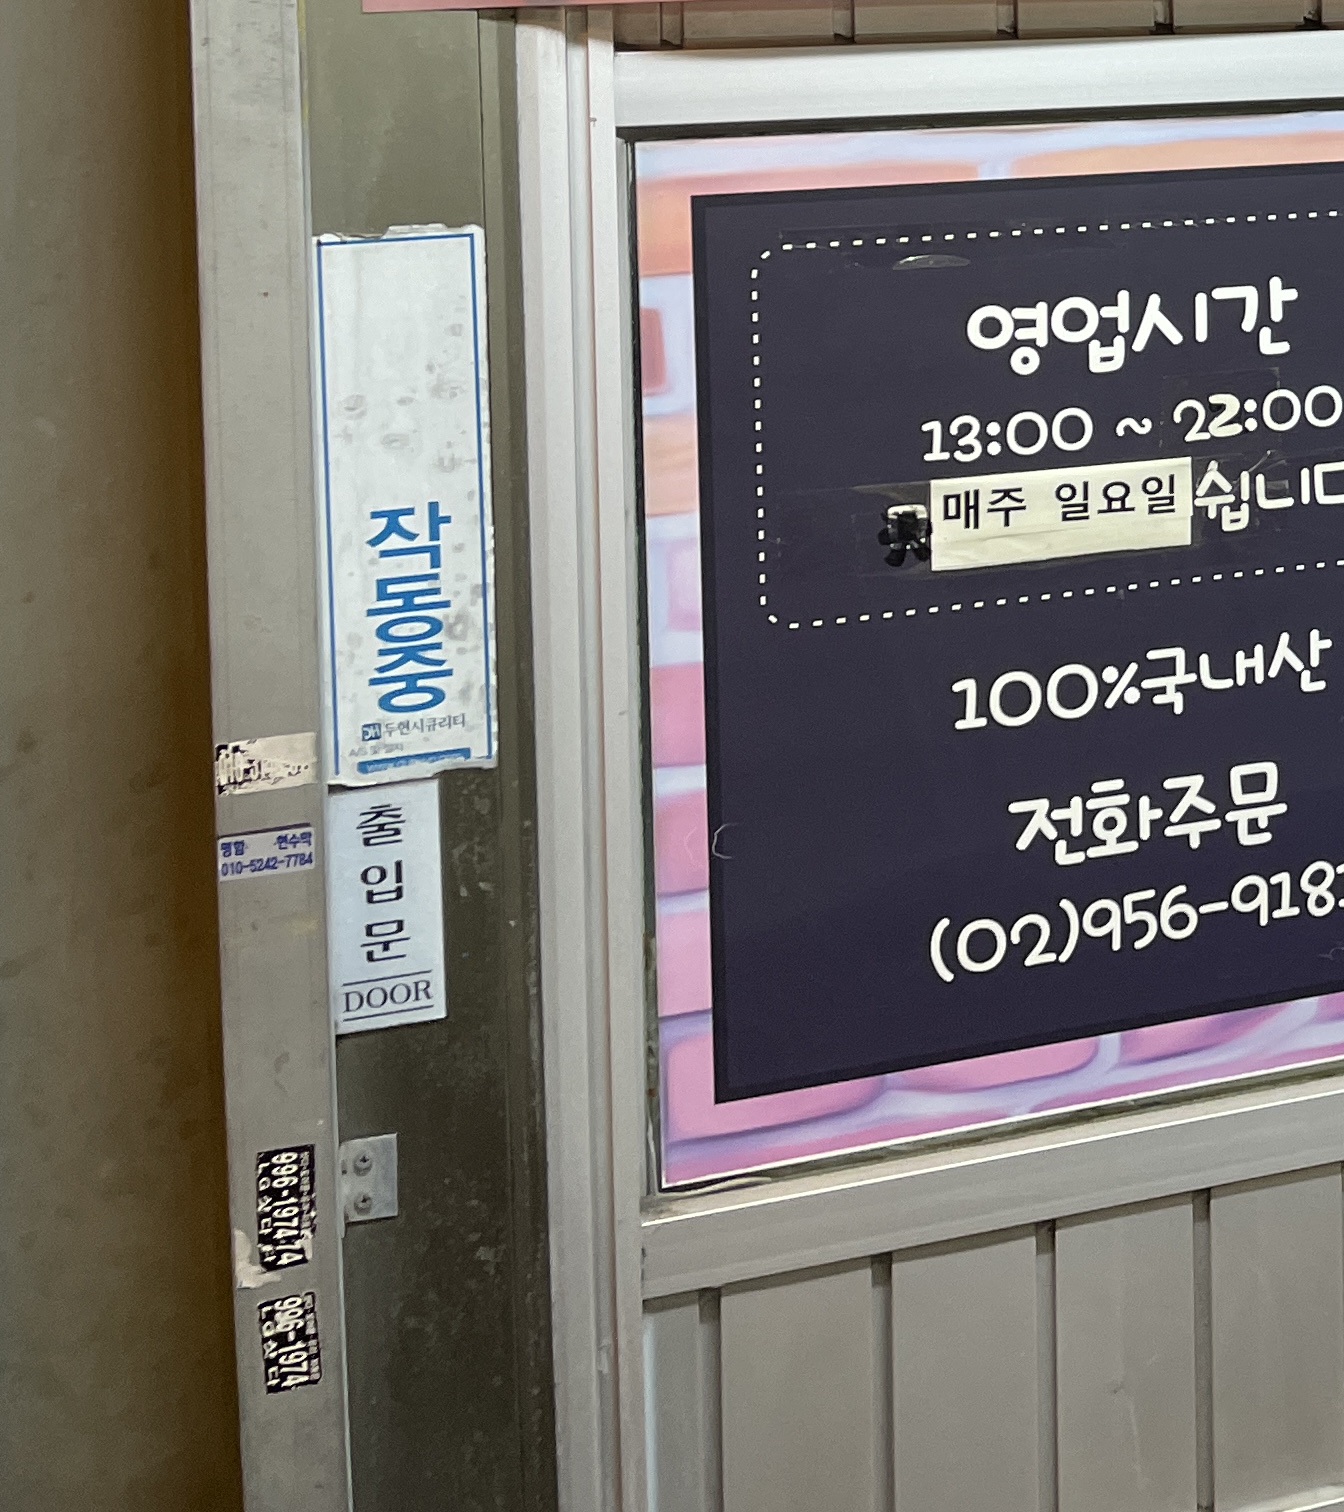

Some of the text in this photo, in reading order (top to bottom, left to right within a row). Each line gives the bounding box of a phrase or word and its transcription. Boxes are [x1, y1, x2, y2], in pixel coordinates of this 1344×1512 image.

[966, 276, 1299, 376] 영업시간
[921, 407, 1094, 463] 13:00
[1173, 385, 1344, 443] 22:00
[942, 487, 1028, 531] 매주
[1054, 473, 1179, 519] 일요일
[366, 500, 455, 715] 작동중
[951, 628, 1334, 731] 100%국내산
[1008, 761, 1288, 867] 전화주문
[356, 804, 410, 964] 출입문
[343, 979, 434, 1014] DOOR
